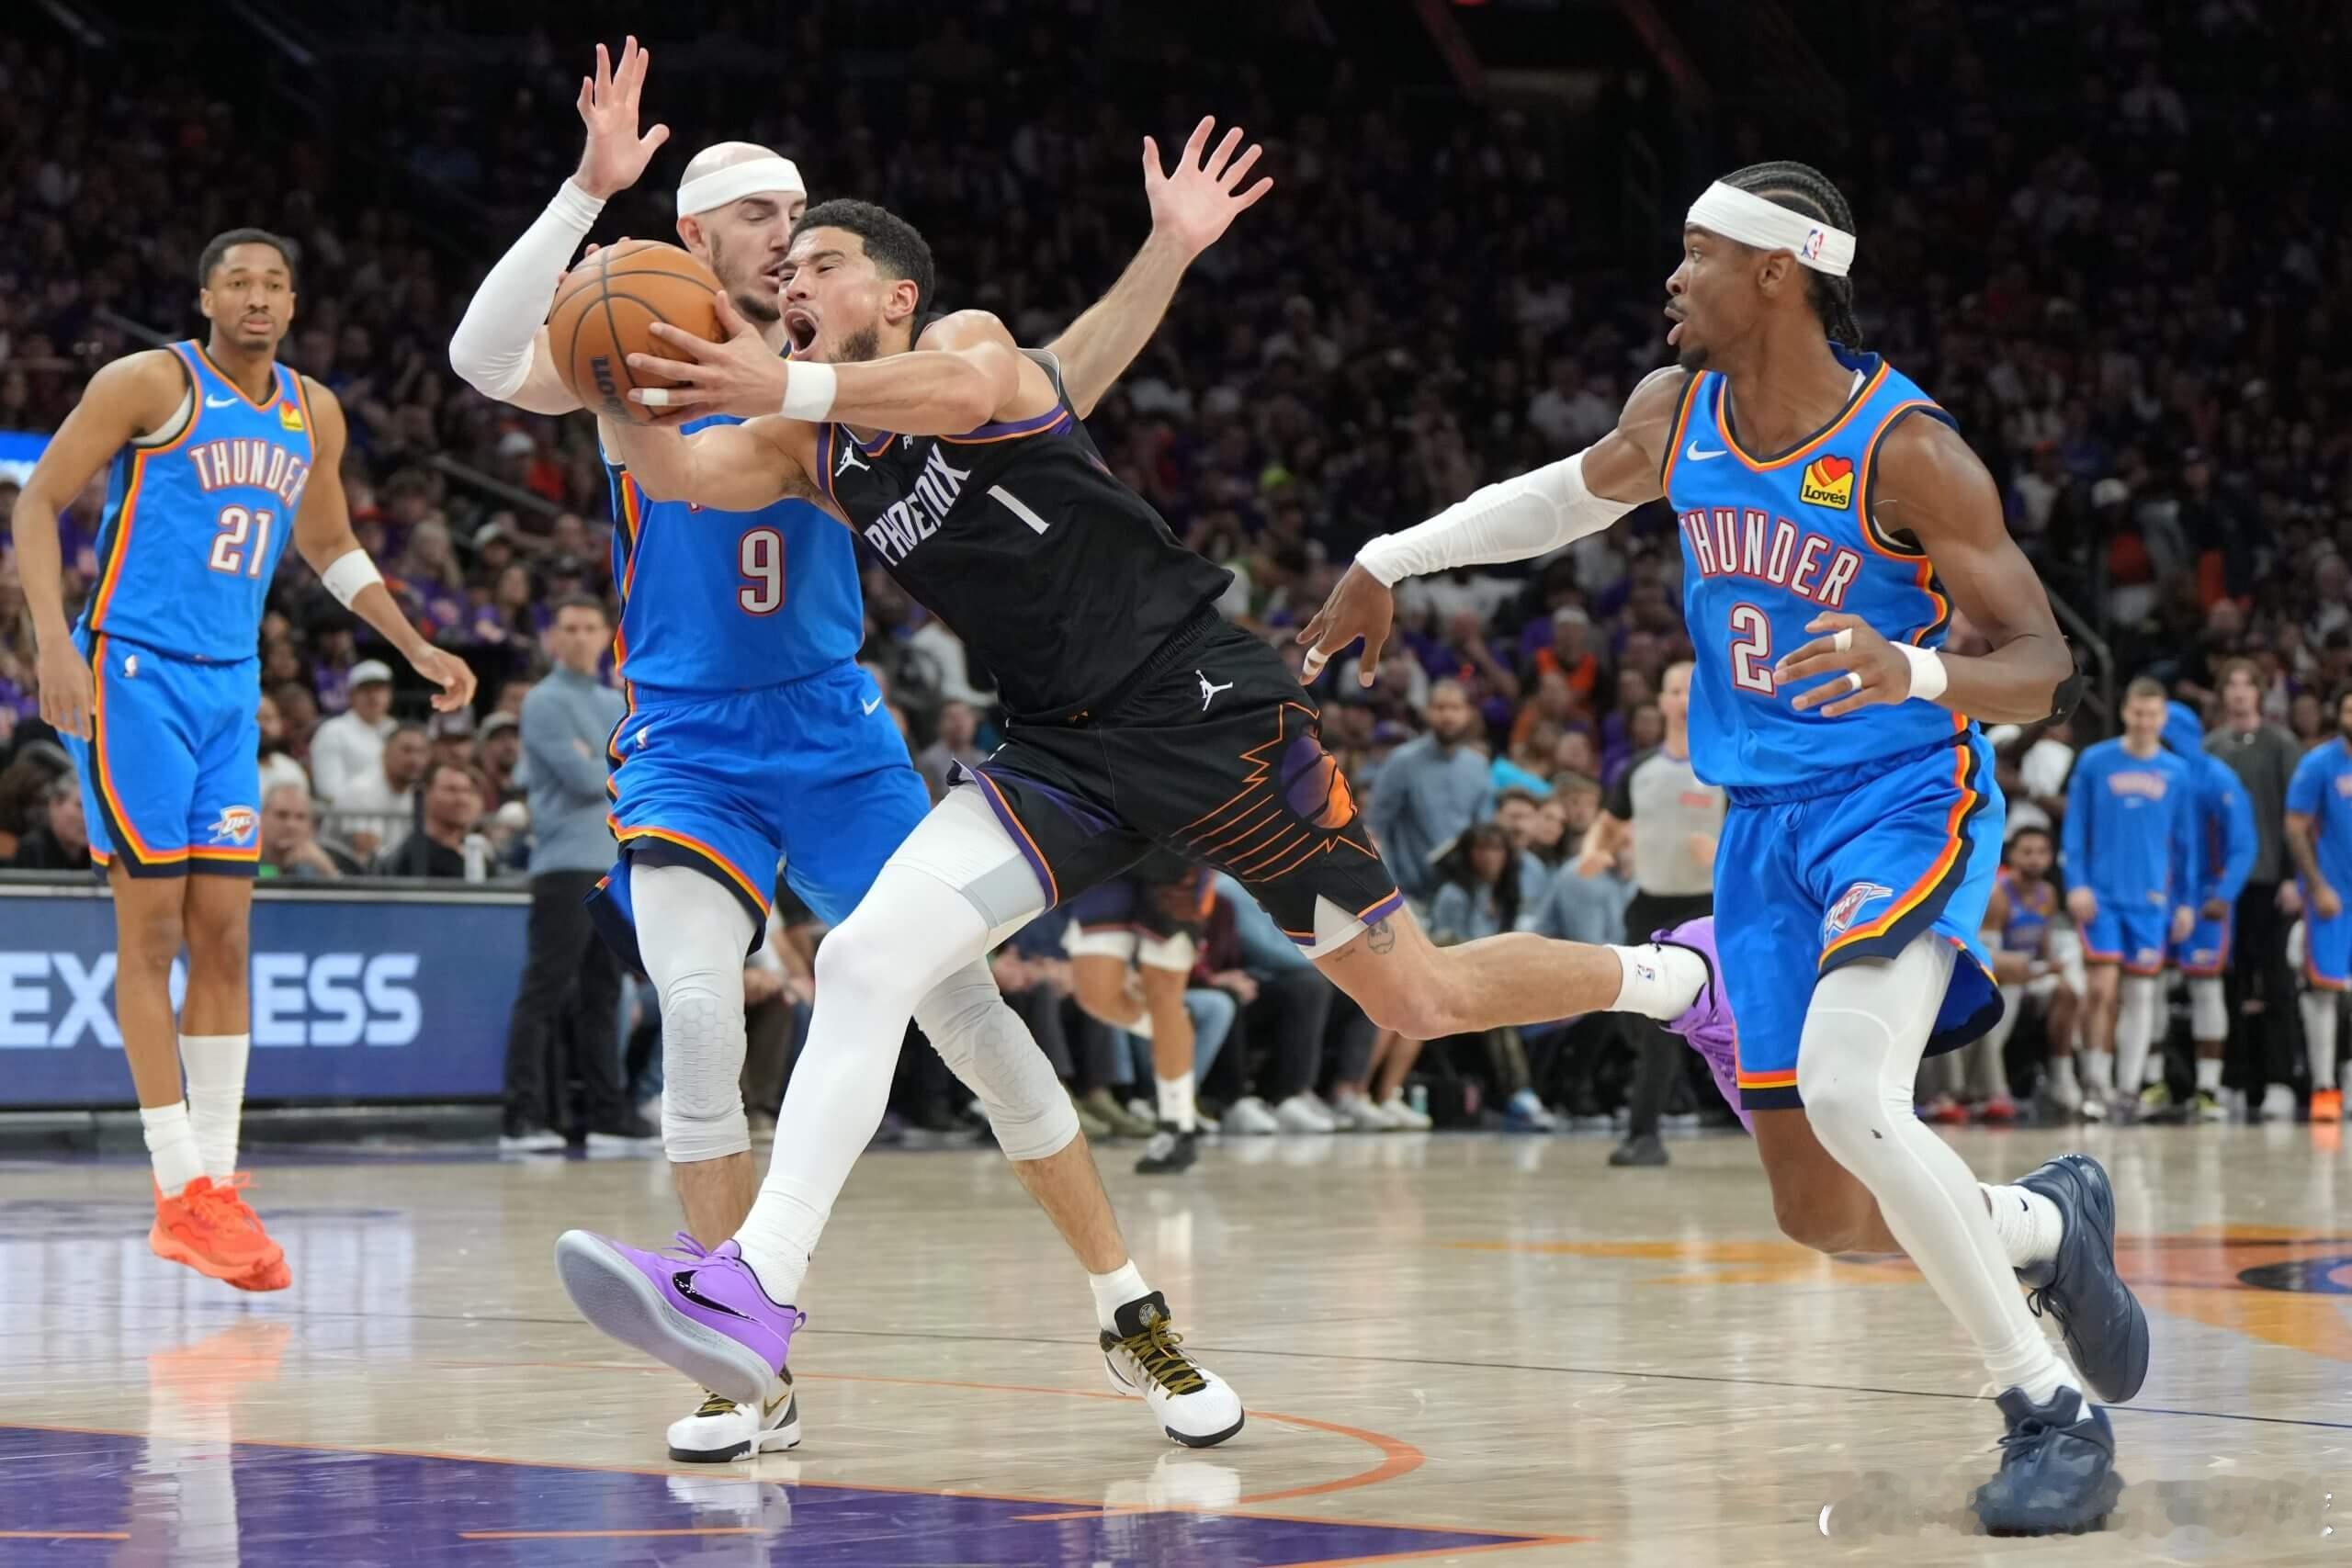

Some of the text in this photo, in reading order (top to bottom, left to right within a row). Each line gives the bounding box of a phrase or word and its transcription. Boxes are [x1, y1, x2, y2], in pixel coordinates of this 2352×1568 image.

[188, 440, 311, 508] THUNDER
[864, 442, 971, 567] PHOENIX
[986, 484, 1050, 536] 1
[208, 504, 274, 579] 21
[738, 525, 786, 616] 9
[1729, 602, 1777, 698] 2
[0, 952, 421, 1048] EXESS
